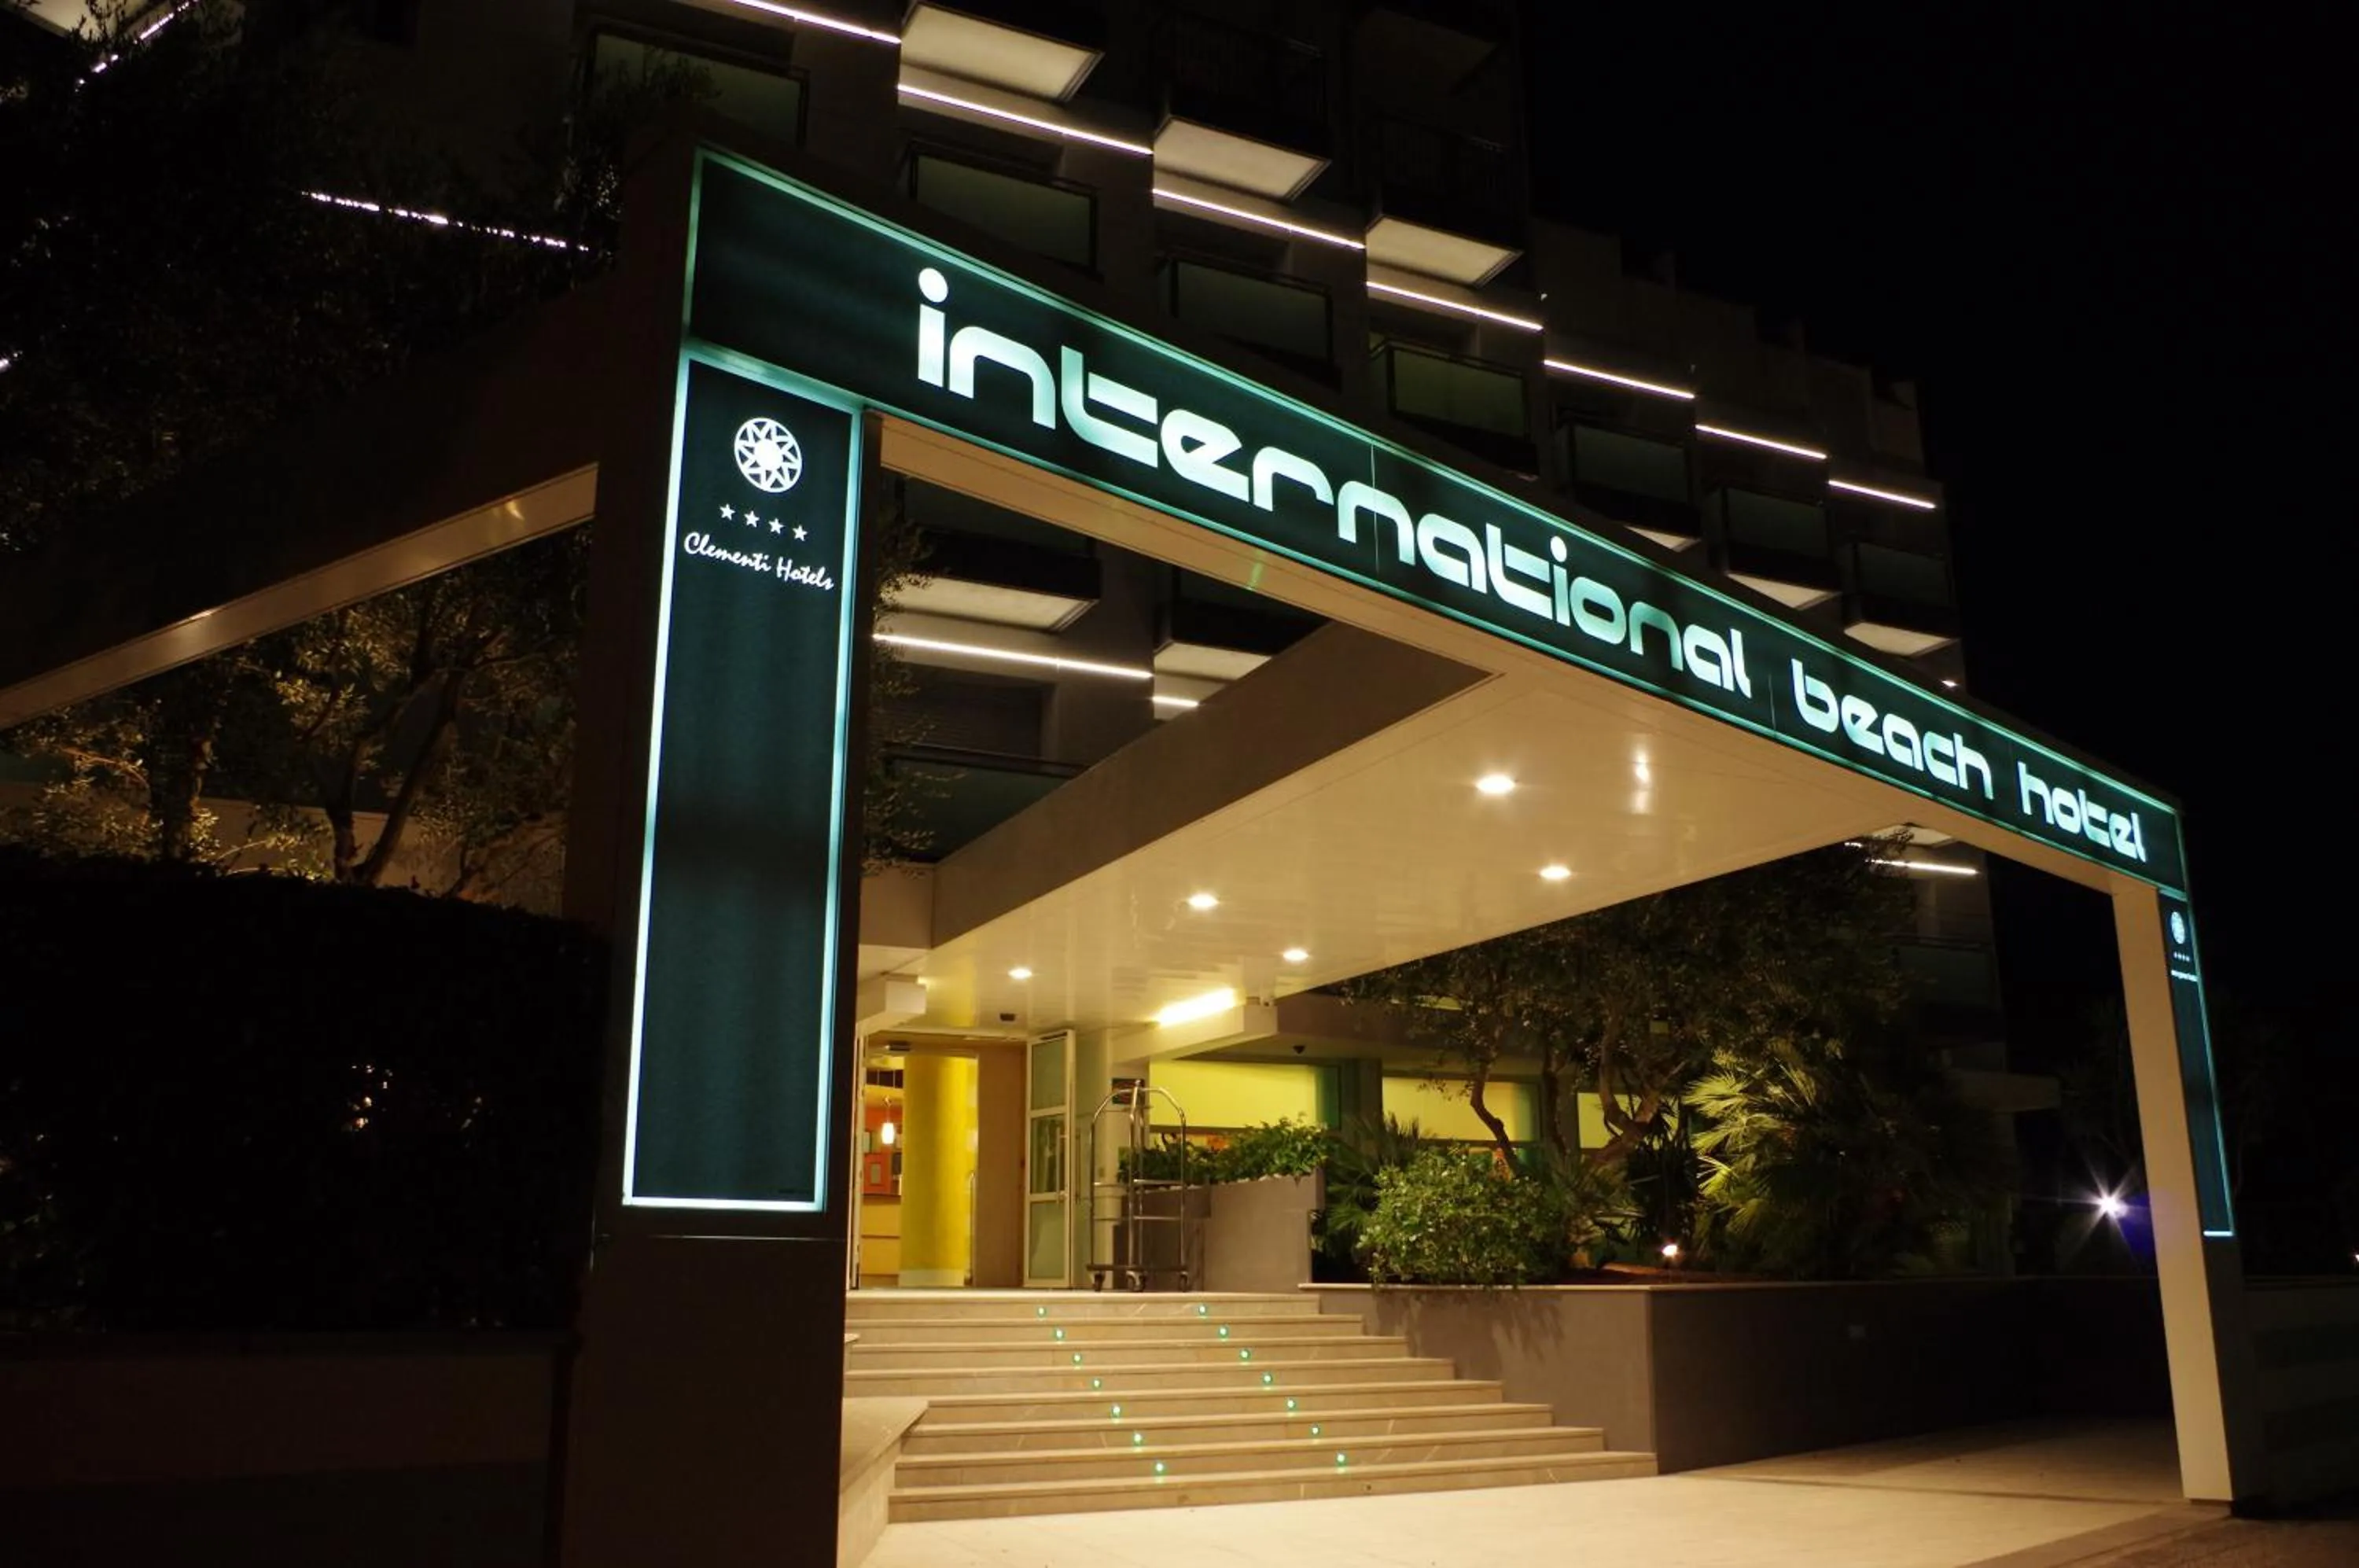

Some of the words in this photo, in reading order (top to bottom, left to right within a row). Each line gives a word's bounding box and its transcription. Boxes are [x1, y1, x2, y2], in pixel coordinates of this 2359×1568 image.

[683, 532, 771, 572] Clementi
[776, 556, 834, 591] Hotels
[918, 268, 1752, 699] international
[1791, 659, 1994, 800] beach
[2017, 761, 2147, 863] hotel
